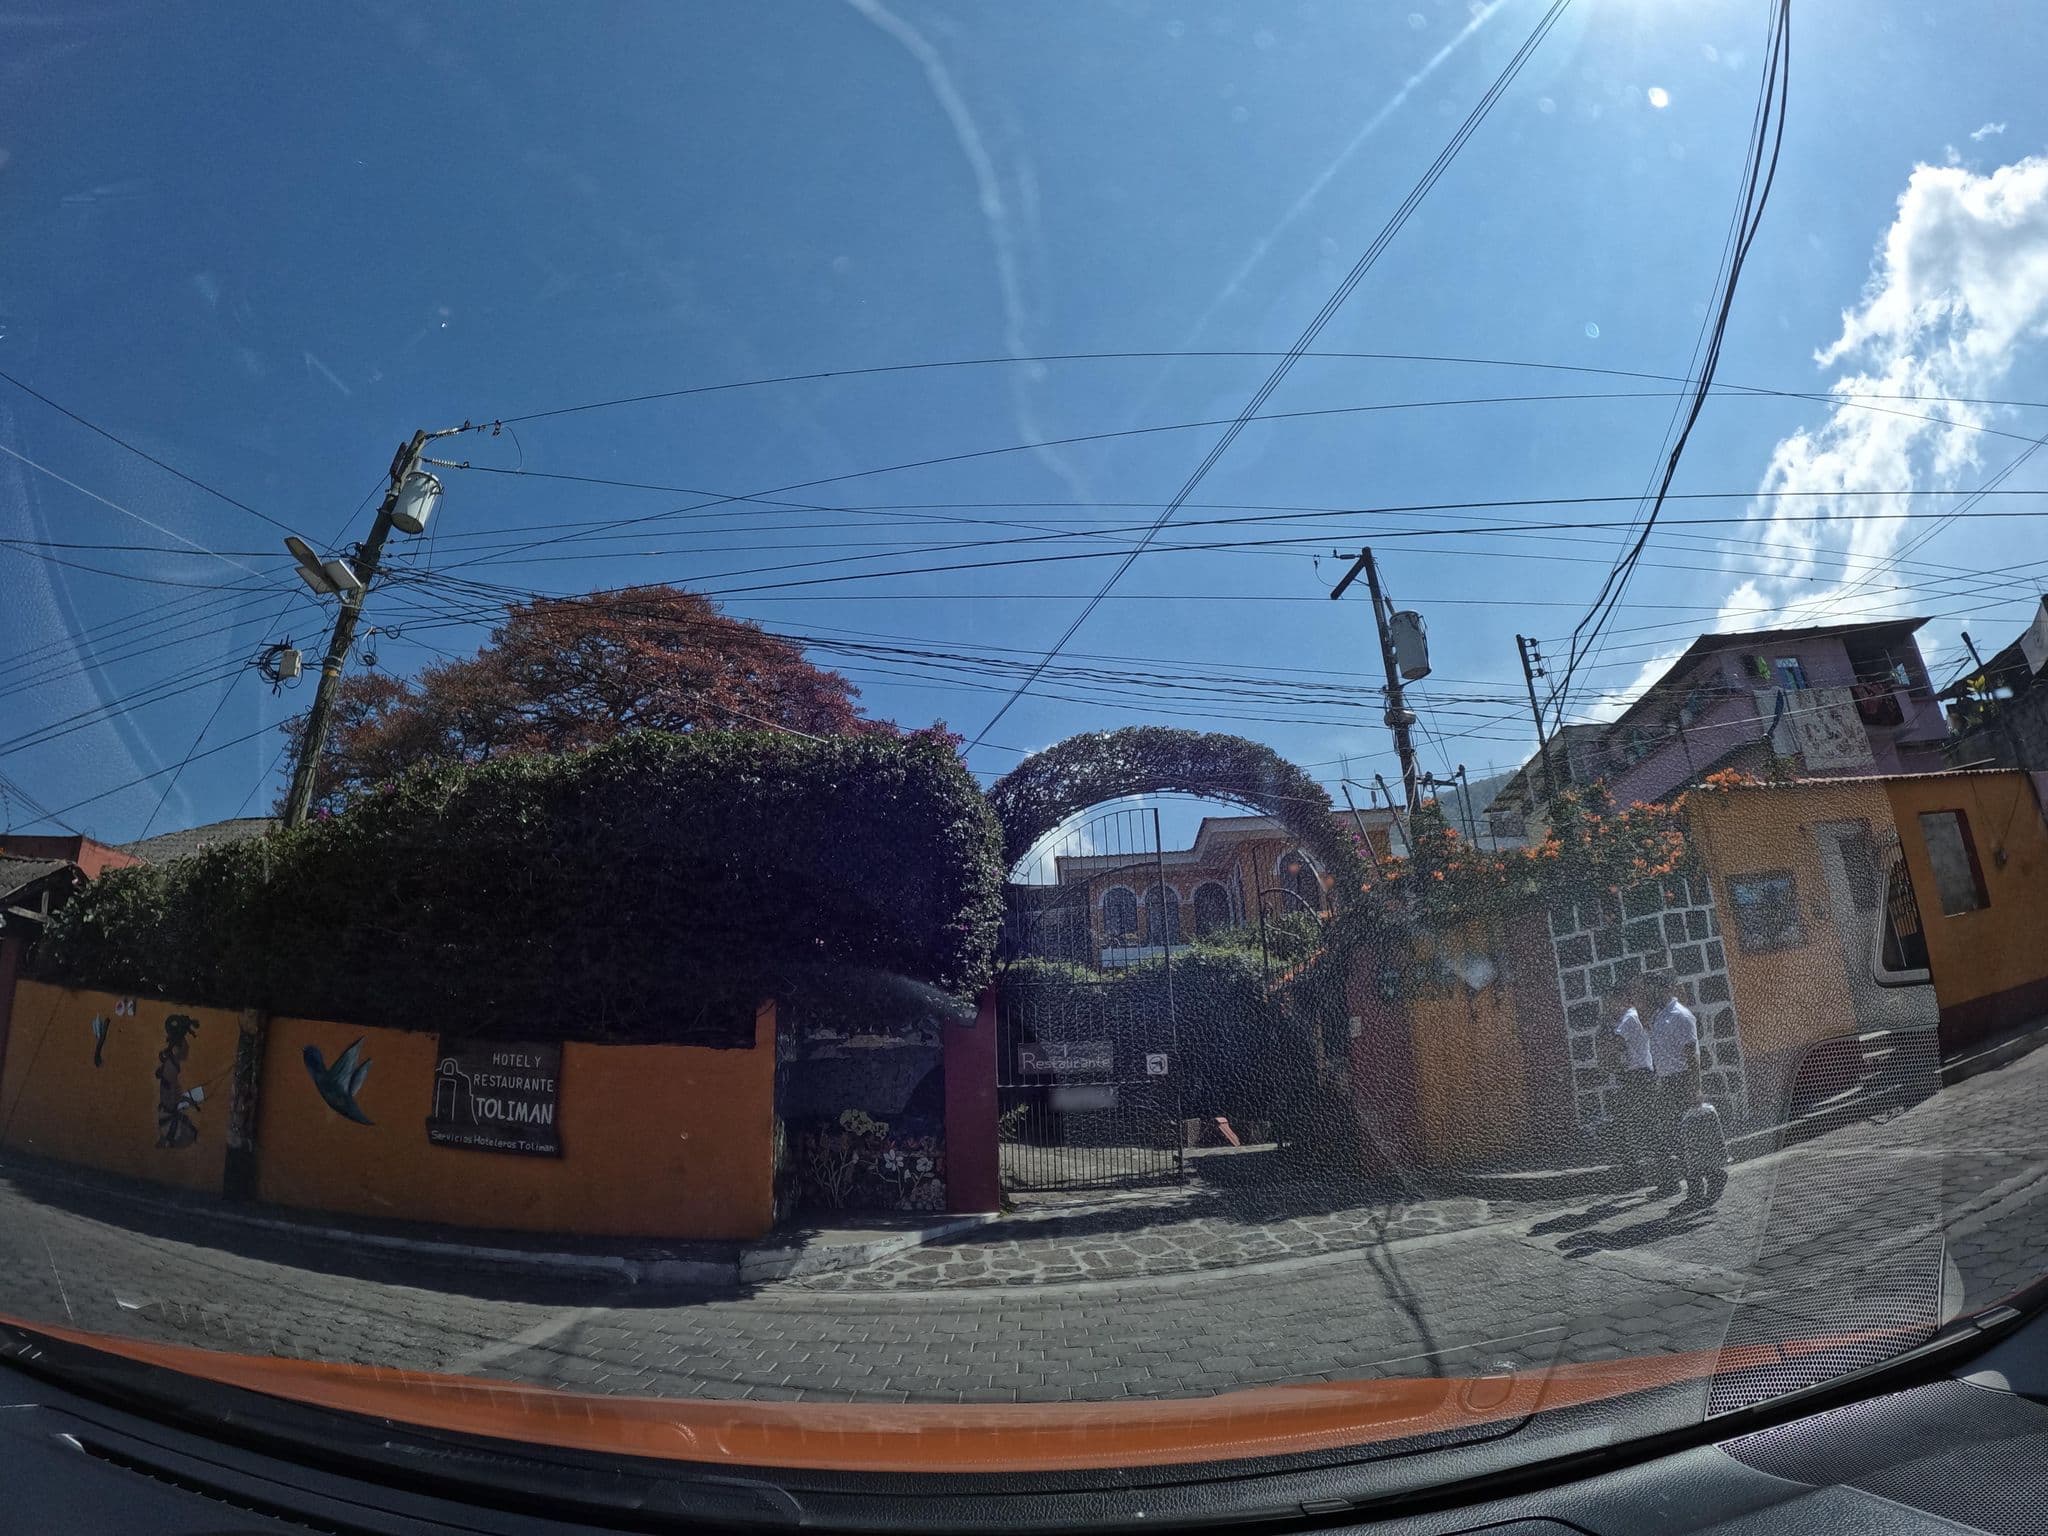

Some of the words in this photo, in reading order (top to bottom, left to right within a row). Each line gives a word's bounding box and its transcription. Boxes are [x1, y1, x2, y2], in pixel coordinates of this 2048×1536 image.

[492, 1052, 531, 1068] HOTEL
[534, 1055, 542, 1068] Y
[1022, 1052, 1111, 1069] Restaurante
[473, 1073, 554, 1093] RESTAURANTE
[475, 1097, 554, 1125] TOLIMAN
